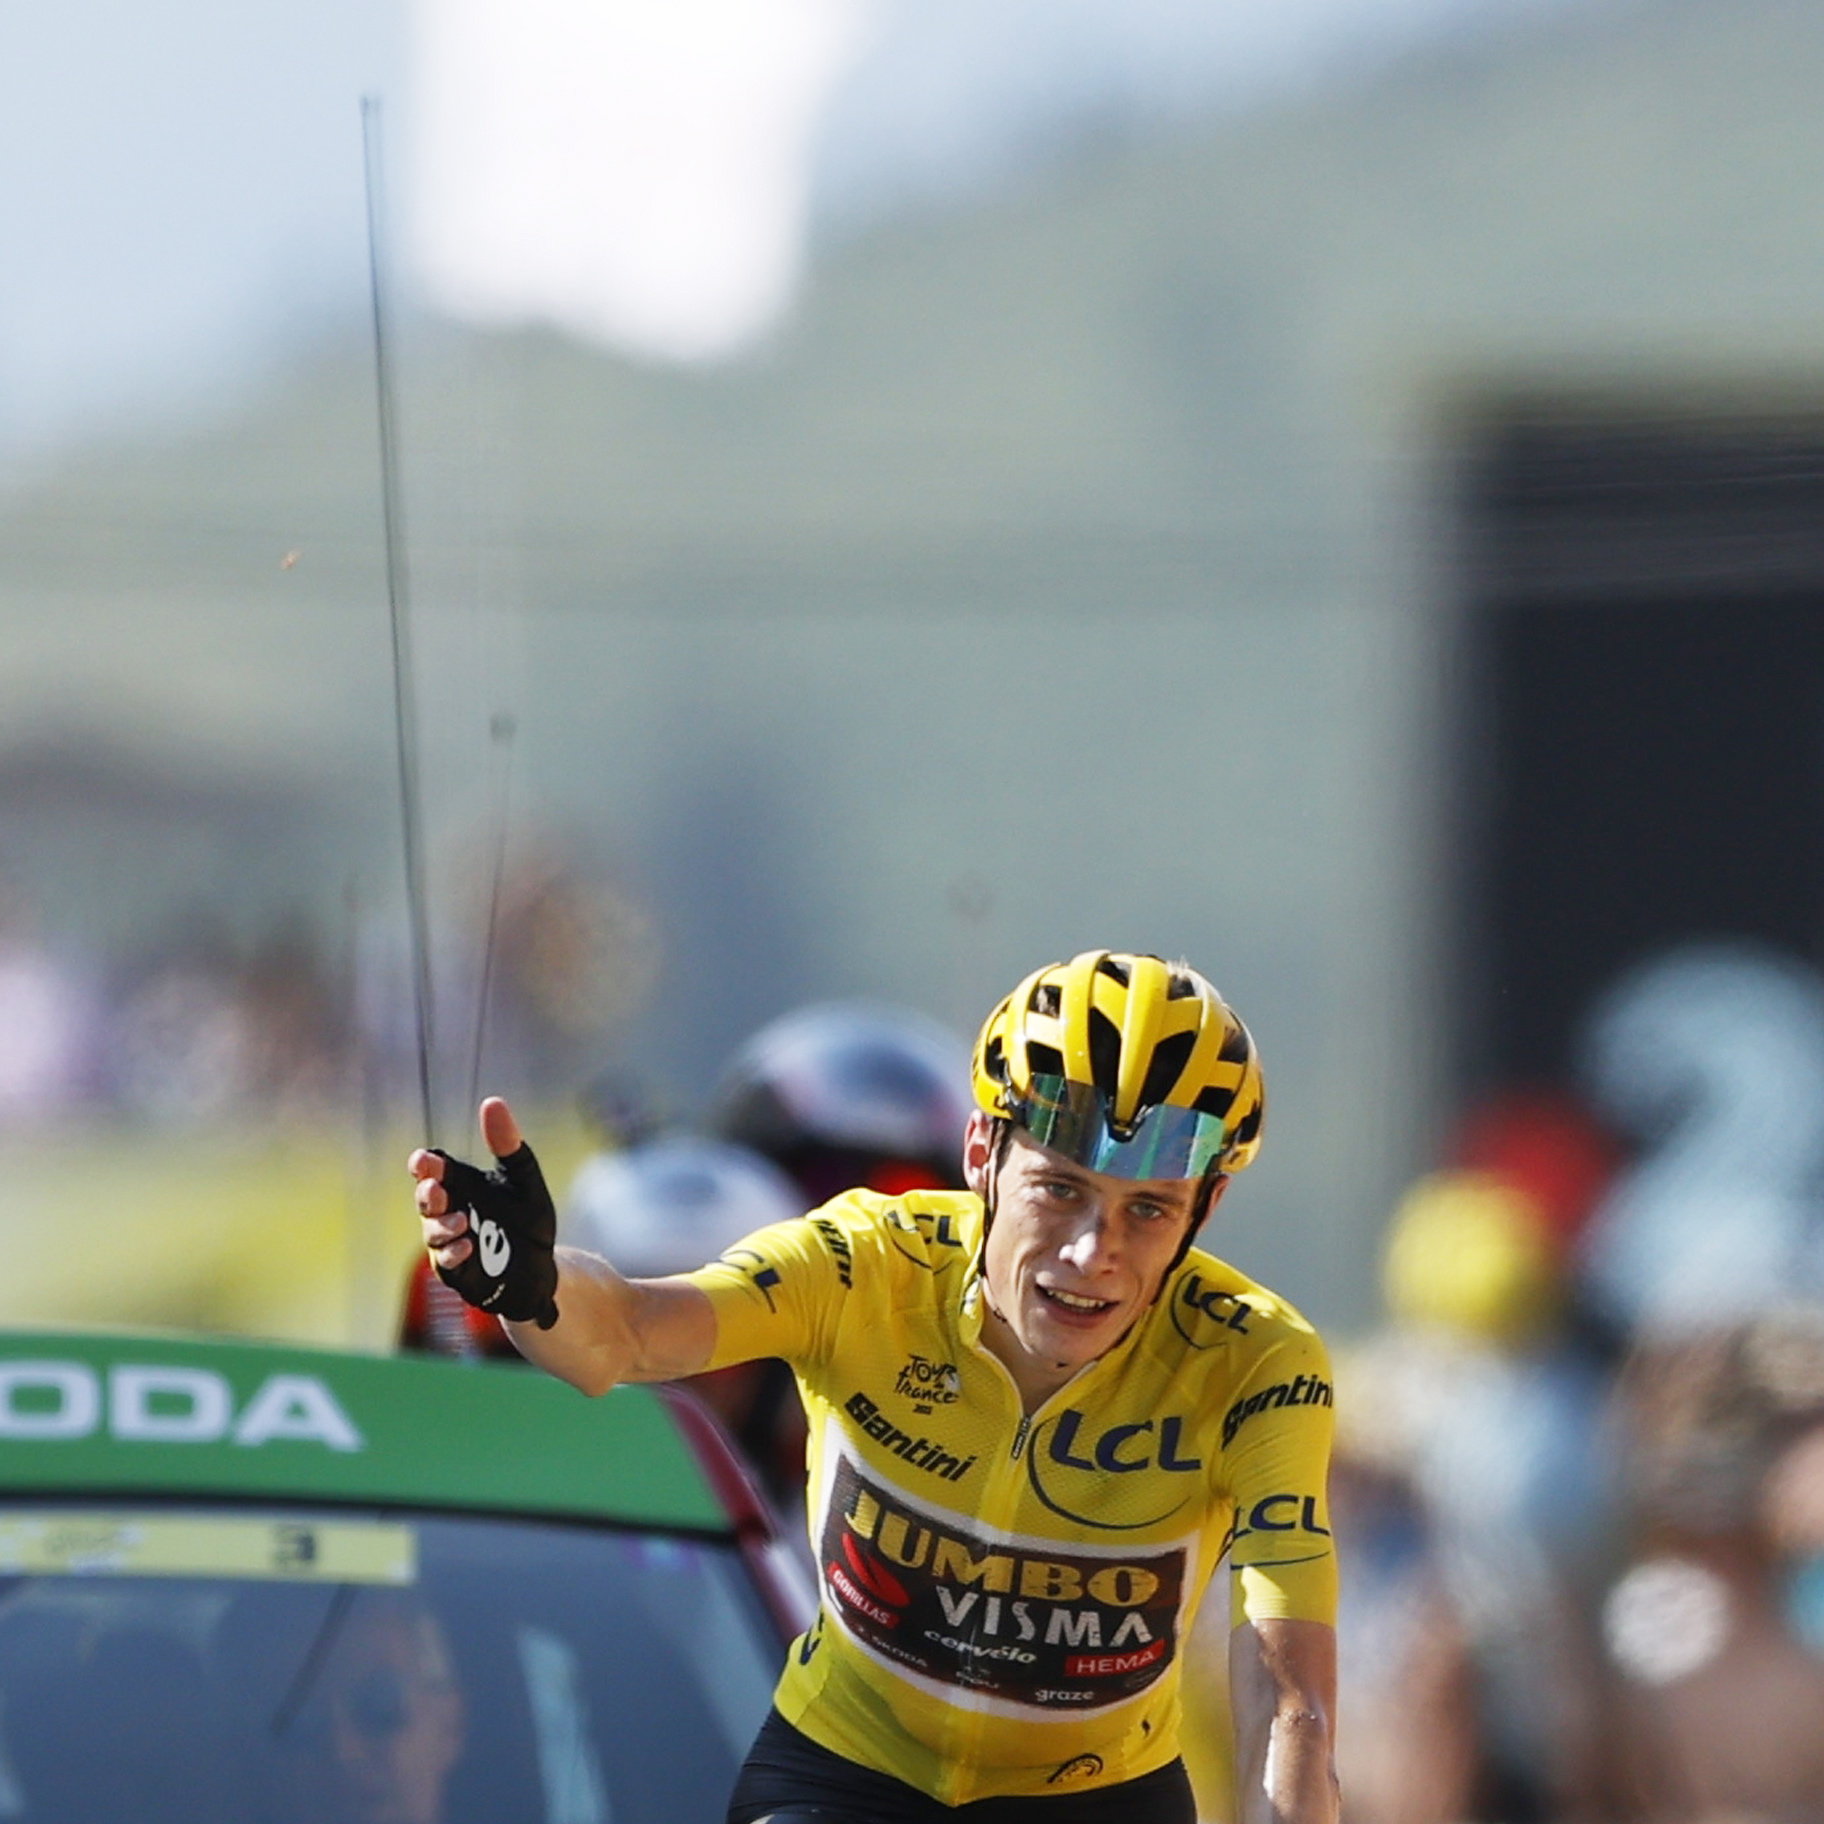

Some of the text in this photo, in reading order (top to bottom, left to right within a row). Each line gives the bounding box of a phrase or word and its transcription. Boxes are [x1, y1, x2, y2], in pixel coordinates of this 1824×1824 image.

[1182, 1275, 1253, 1336] LCL
[1049, 1409, 1202, 1474] LCL
[844, 1489, 1160, 1607] JUMBO
[832, 1569, 890, 1624] GORILLAS
[936, 1585, 1154, 1648] VISMA
[1077, 1649, 1156, 1675] HEMA
[1035, 1688, 1095, 1702] graze
